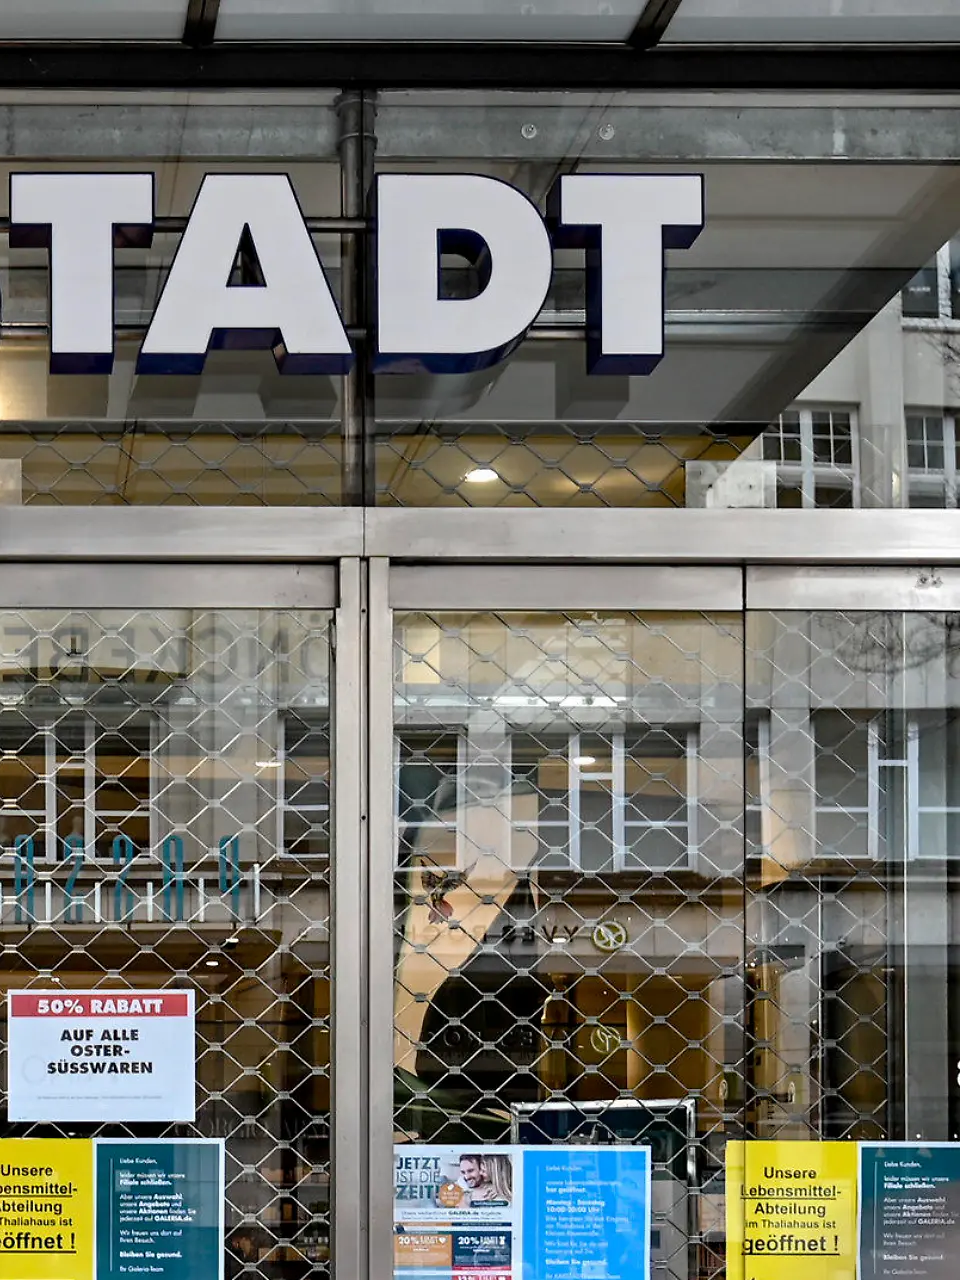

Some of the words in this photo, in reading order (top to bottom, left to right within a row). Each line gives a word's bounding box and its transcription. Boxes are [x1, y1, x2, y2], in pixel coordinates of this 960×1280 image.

[38, 1000, 84, 1014] 50%
[91, 1000, 163, 1013] RABATT
[61, 1030, 93, 1041] AUF
[101, 1029, 139, 1041] ALLE
[71, 1045, 130, 1057] OSTER-
[47, 1060, 153, 1074] SÜSSWAREN
[396, 1157, 440, 1169] JETZT
[0, 1164, 53, 1176] Unsere
[763, 1167, 817, 1179] Unsere
[396, 1171, 414, 1183] IST
[420, 1171, 440, 1183] DIE
[396, 1185, 439, 1200] ZEIT!
[754, 1202, 826, 1217] Abteilung
[59, 1217, 73, 1226] ist
[744, 1219, 758, 1229] im
[762, 1218, 819, 1229] Thaliahaus
[823, 1219, 836, 1229] ist
[458, 1236, 479, 1244] 20%
[742, 1235, 827, 1254] geöffnet
